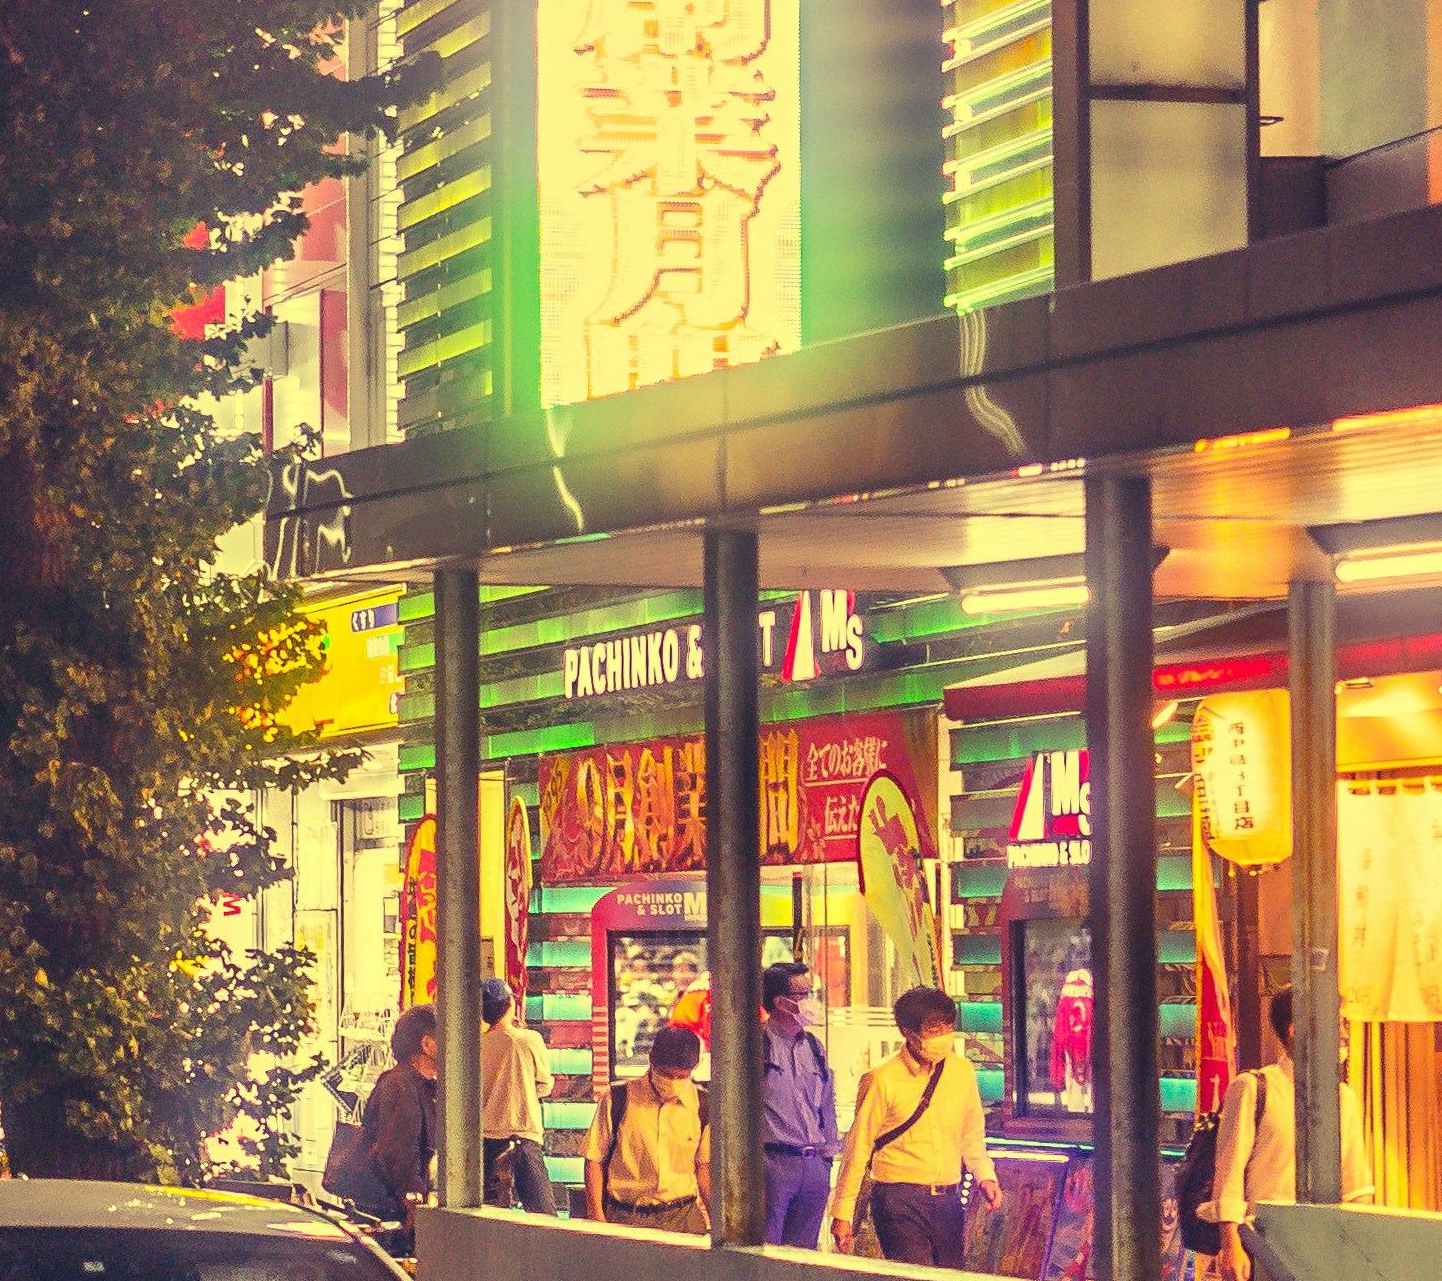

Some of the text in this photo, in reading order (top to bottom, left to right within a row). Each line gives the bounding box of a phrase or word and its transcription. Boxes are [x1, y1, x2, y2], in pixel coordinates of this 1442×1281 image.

[563, 628, 681, 700] PACHINKO
[685, 623, 706, 680] &
[616, 892, 683, 905] PACHINKO
[636, 904, 646, 916] &
[649, 903, 683, 916] SLOT
